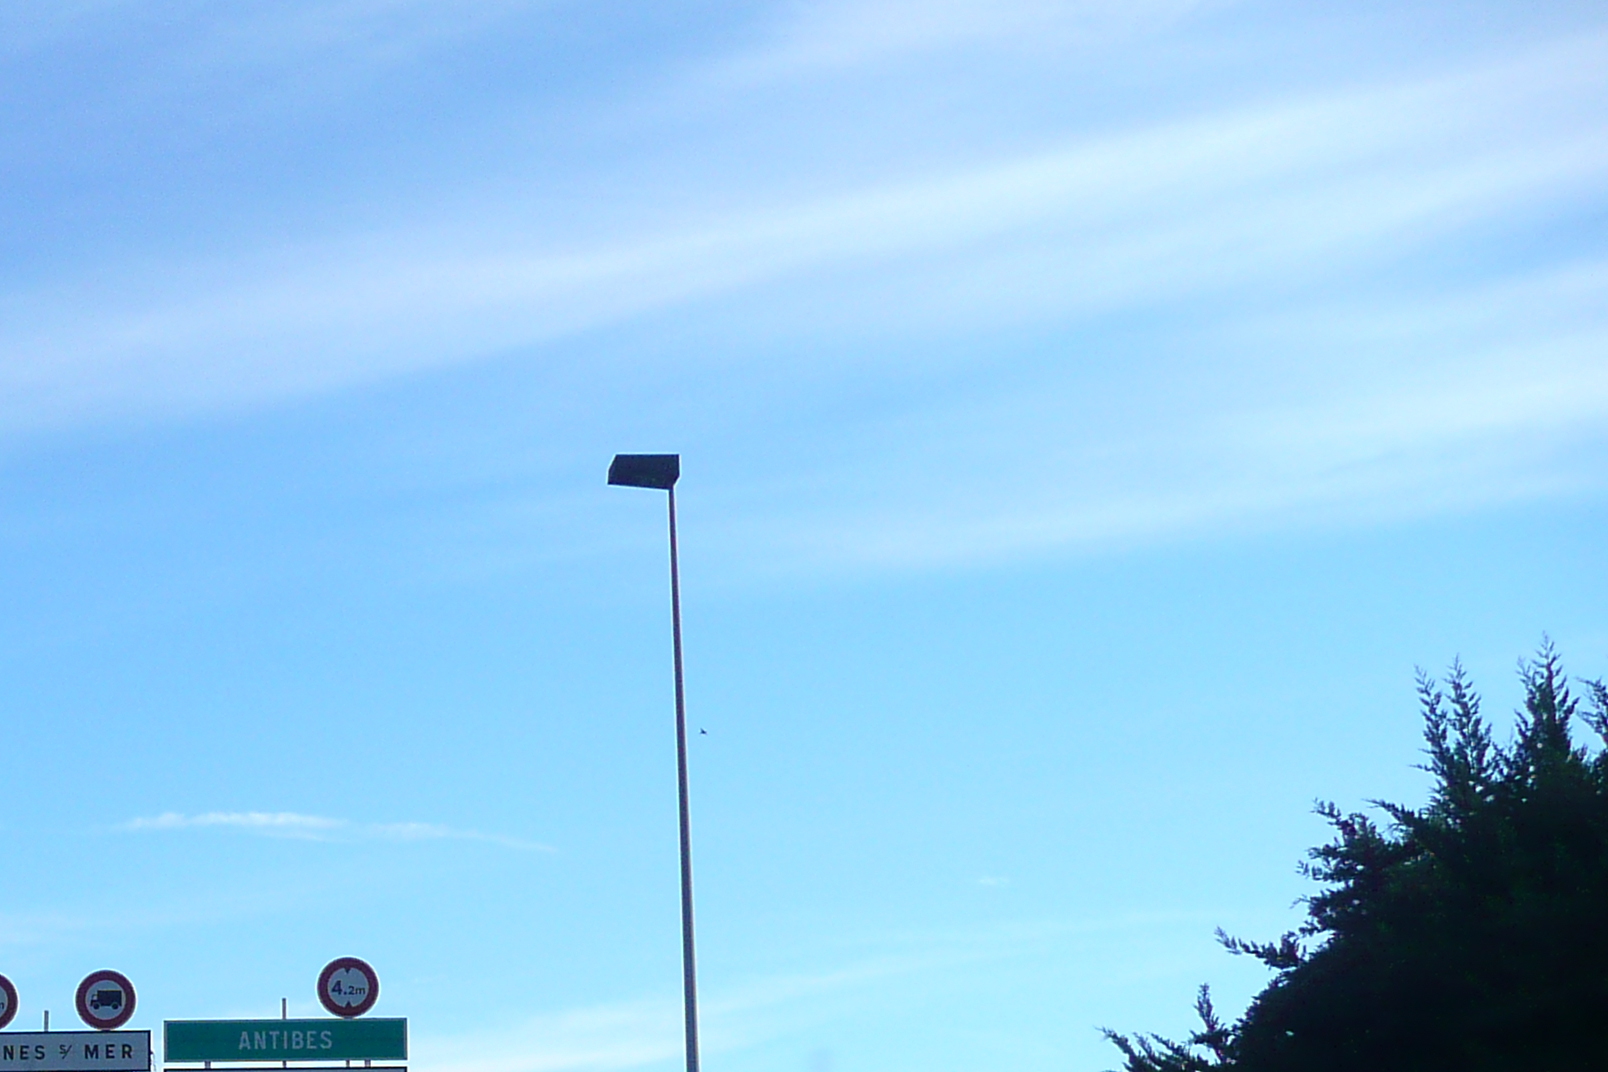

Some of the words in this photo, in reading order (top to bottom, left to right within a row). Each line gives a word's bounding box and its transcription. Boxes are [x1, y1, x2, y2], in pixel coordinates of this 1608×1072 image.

[331, 980, 366, 995] 4.2m
[238, 1030, 333, 1050] ANTIBES
[84, 1043, 133, 1059] MER
